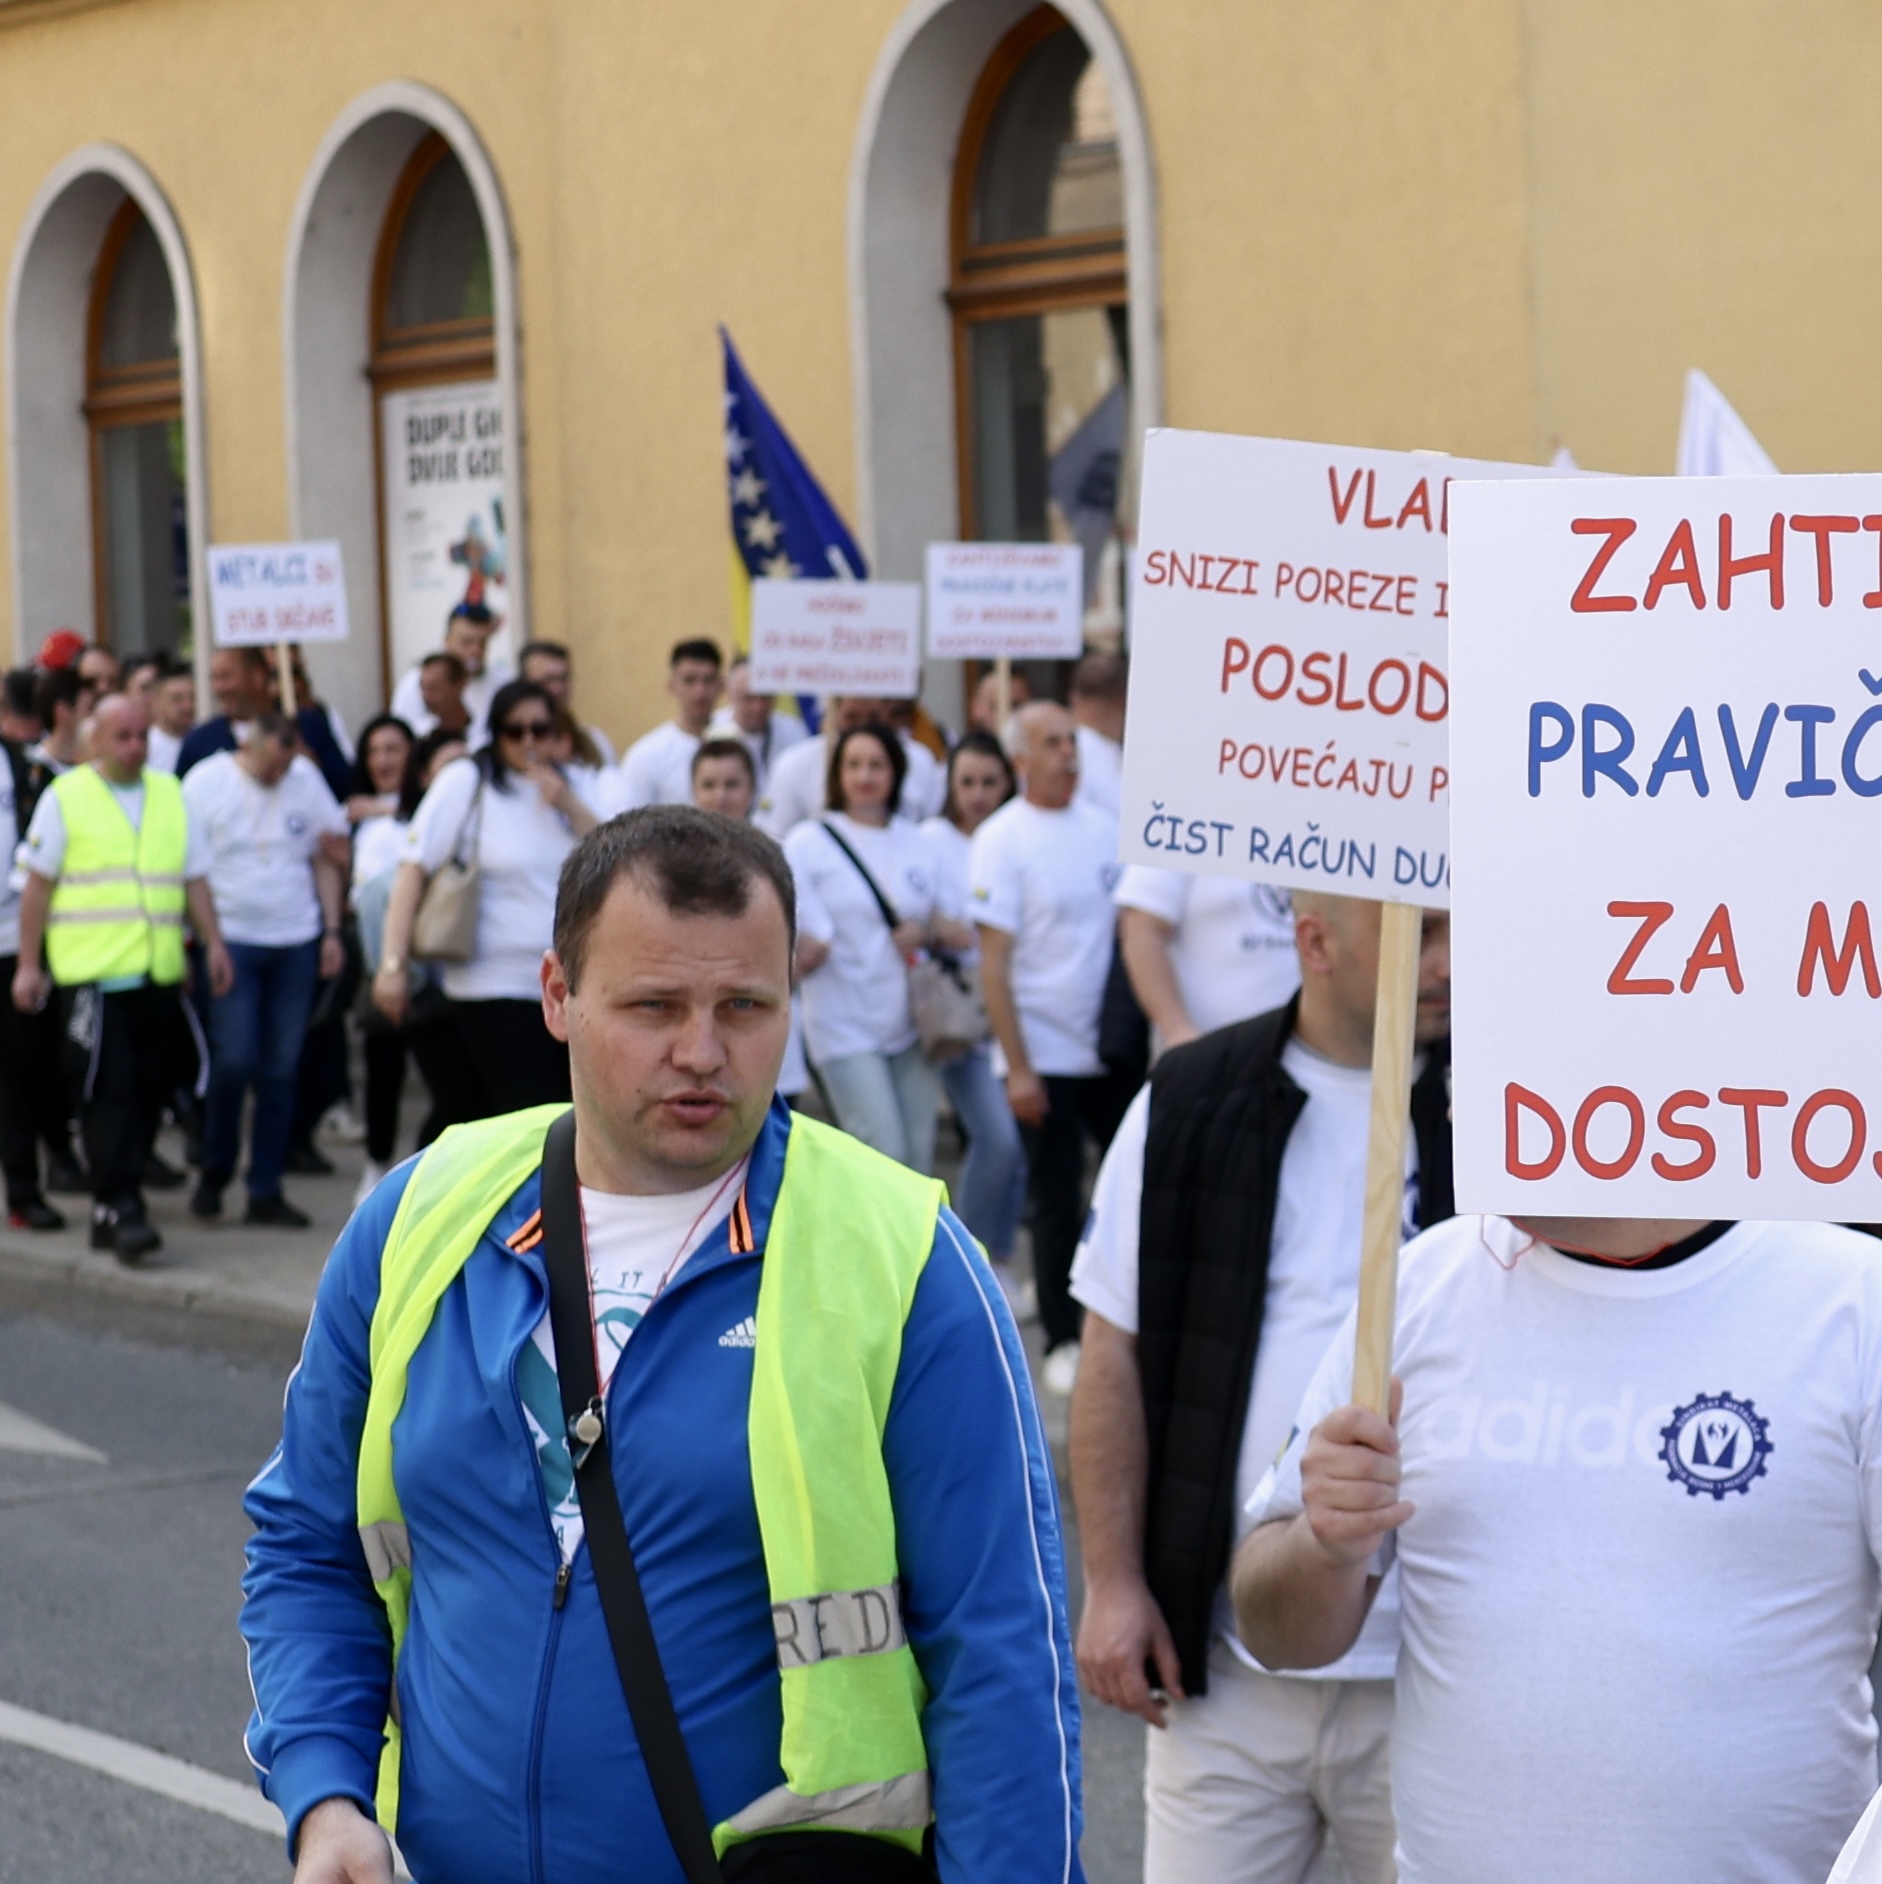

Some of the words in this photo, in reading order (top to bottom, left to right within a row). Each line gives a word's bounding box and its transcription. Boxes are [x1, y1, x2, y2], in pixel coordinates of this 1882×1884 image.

[1144, 549, 1260, 596] SNIZI
[1276, 561, 1418, 616] POREZE
[1218, 738, 1413, 800] POVEĆAJU
[1143, 800, 1235, 857] ČIST
[1248, 820, 1377, 869] RAČUN
[1393, 845, 1449, 889] DU
[1607, 900, 1746, 996] ZA
